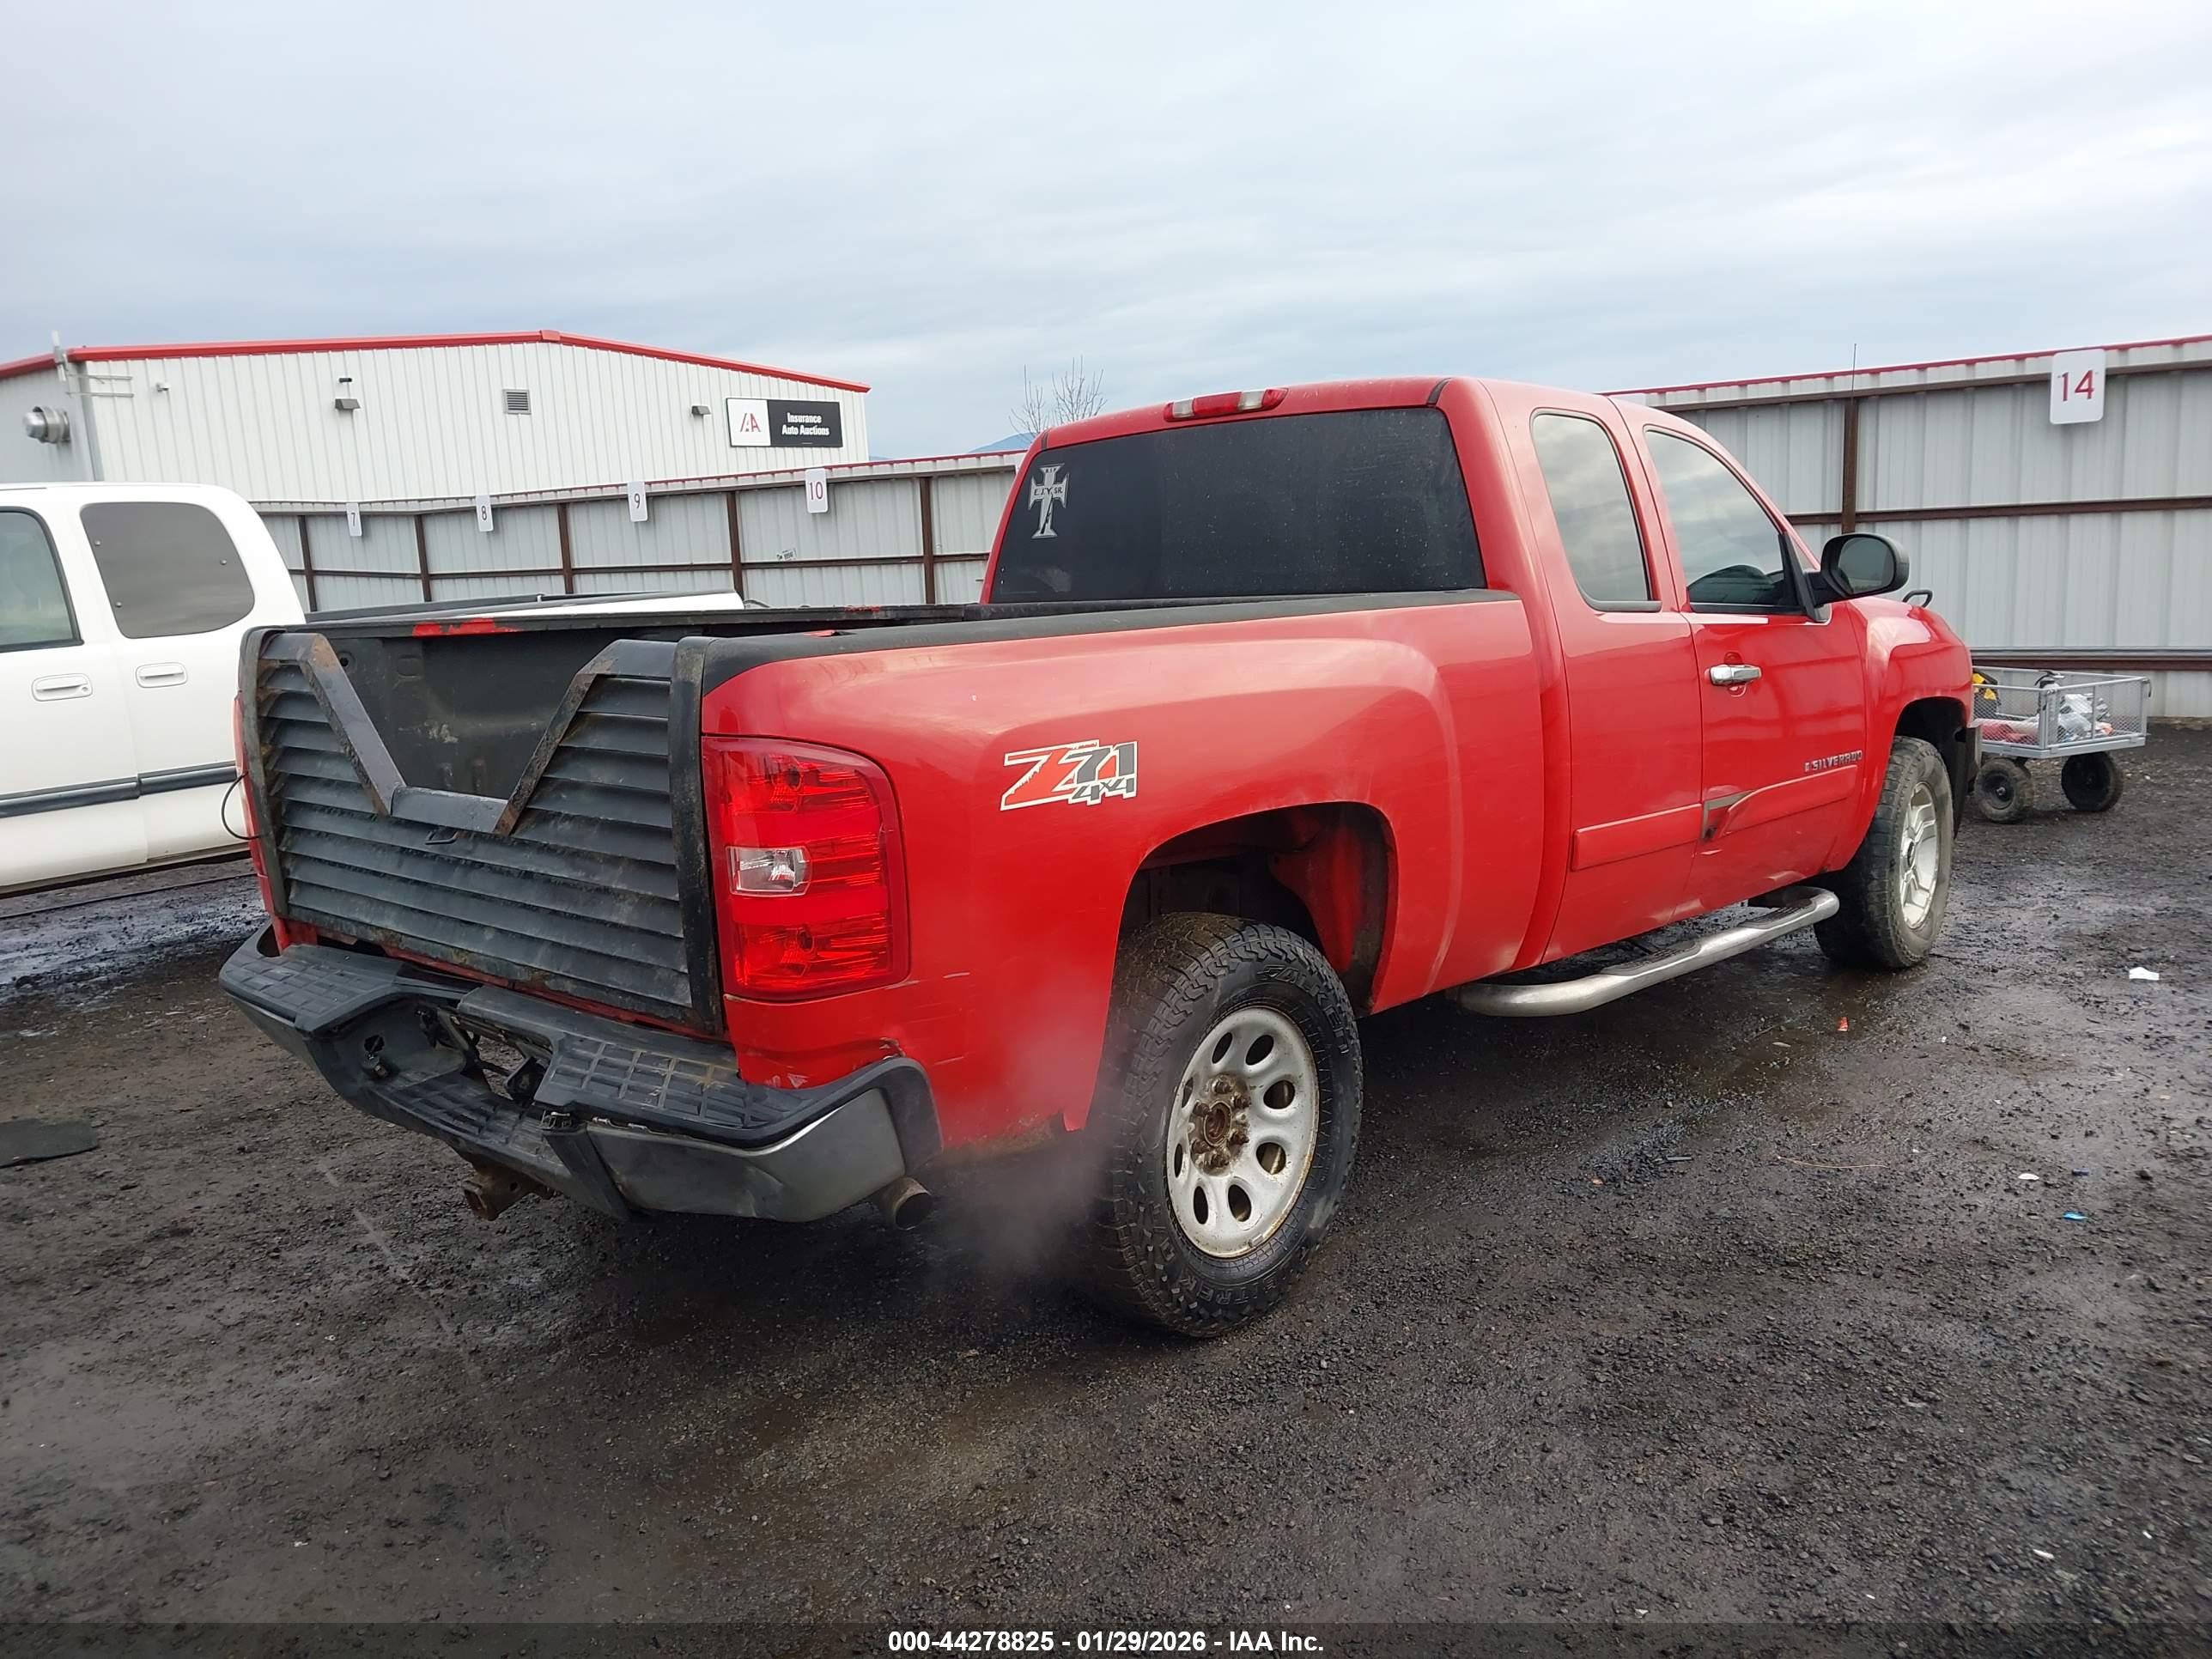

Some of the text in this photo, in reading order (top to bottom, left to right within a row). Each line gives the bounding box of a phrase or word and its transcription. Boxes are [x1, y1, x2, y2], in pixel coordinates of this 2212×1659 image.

[2061, 369, 2095, 402] 14
[787, 412, 822, 423] Insurance
[781, 424, 830, 435] Auto Auctions
[809, 481, 823, 501] 10
[634, 493, 641, 509] 9
[350, 512, 356, 526] 7
[481, 505, 488, 521] 8
[1812, 750, 1863, 771] SILVERADO
[1000, 739, 1138, 811] Z71
